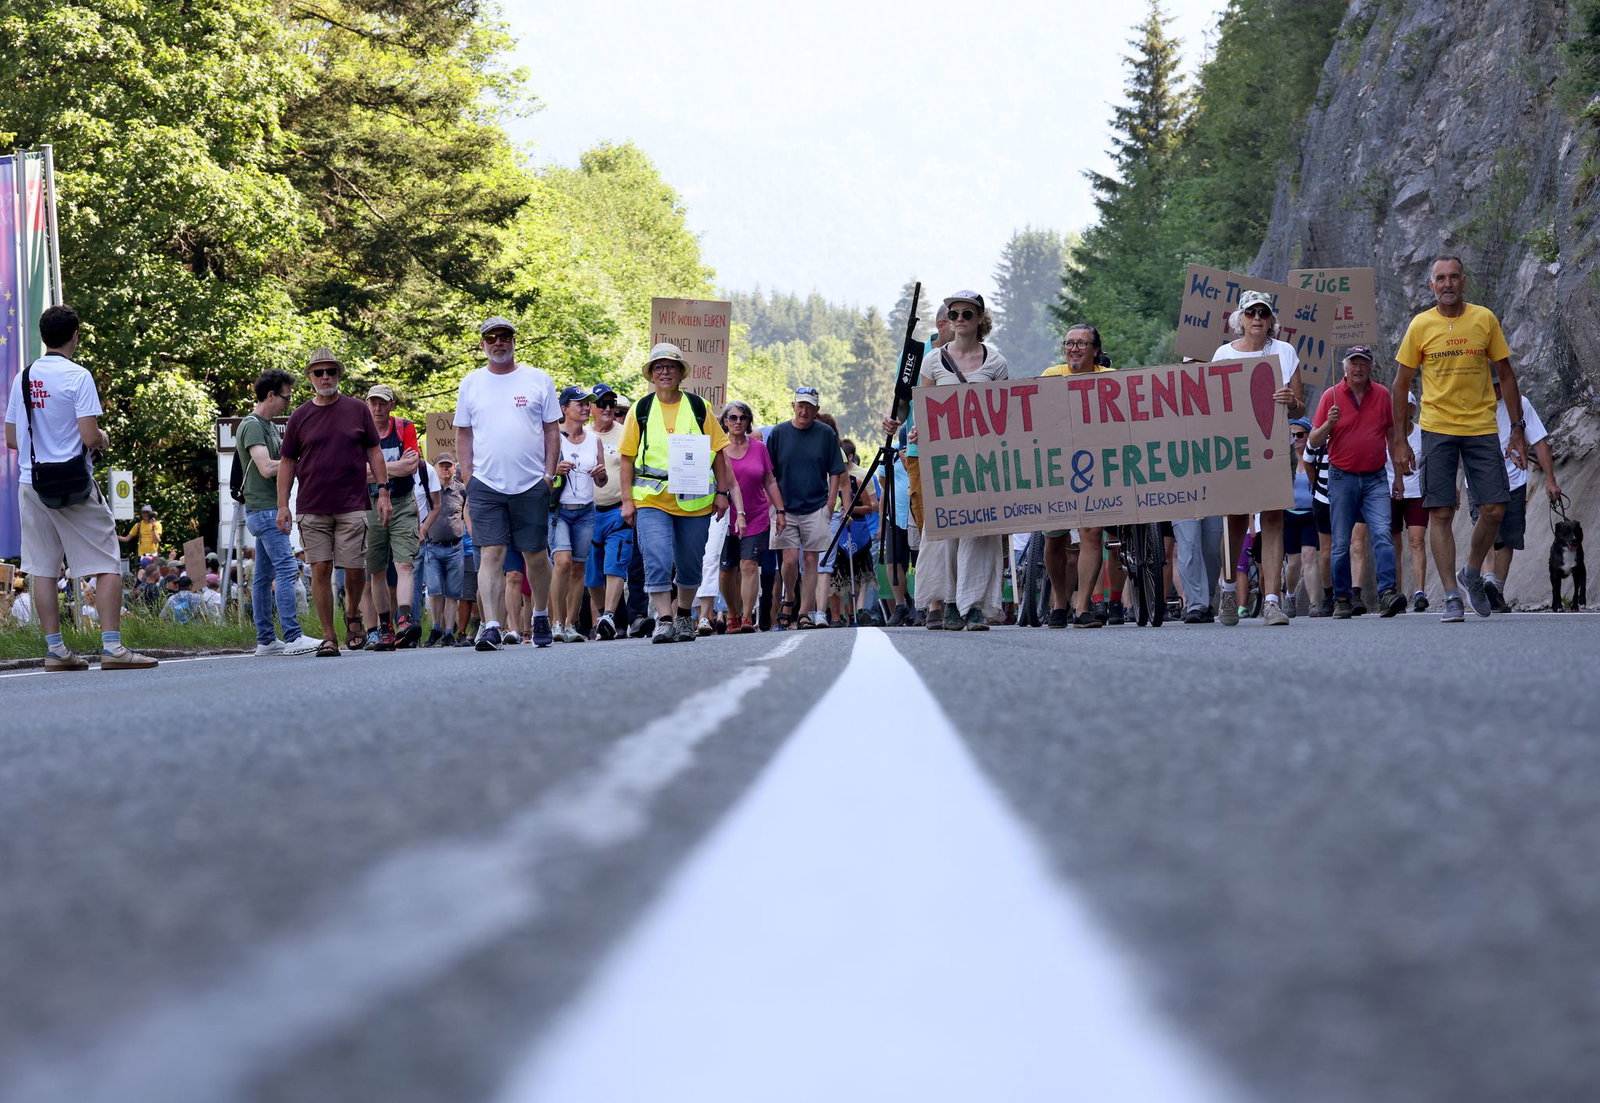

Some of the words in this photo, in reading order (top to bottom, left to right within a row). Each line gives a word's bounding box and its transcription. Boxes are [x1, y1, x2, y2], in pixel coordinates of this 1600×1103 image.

[1300, 272, 1351, 293] ZÜGE
[1190, 273, 1222, 300] Wer
[1294, 303, 1318, 323] sät
[659, 311, 677, 327] WIR
[1184, 310, 1211, 329] wird
[1446, 338, 1469, 347] STOPP
[29, 379, 43, 388] ste
[31, 399, 45, 408] rol
[925, 384, 1039, 442] MAUT
[1070, 449, 1095, 493] &
[1102, 435, 1252, 488] FREUNDE
[935, 506, 998, 529] BESUCHE
[1003, 502, 1042, 519] DÜRFEN
[1047, 499, 1078, 514] KEIN
